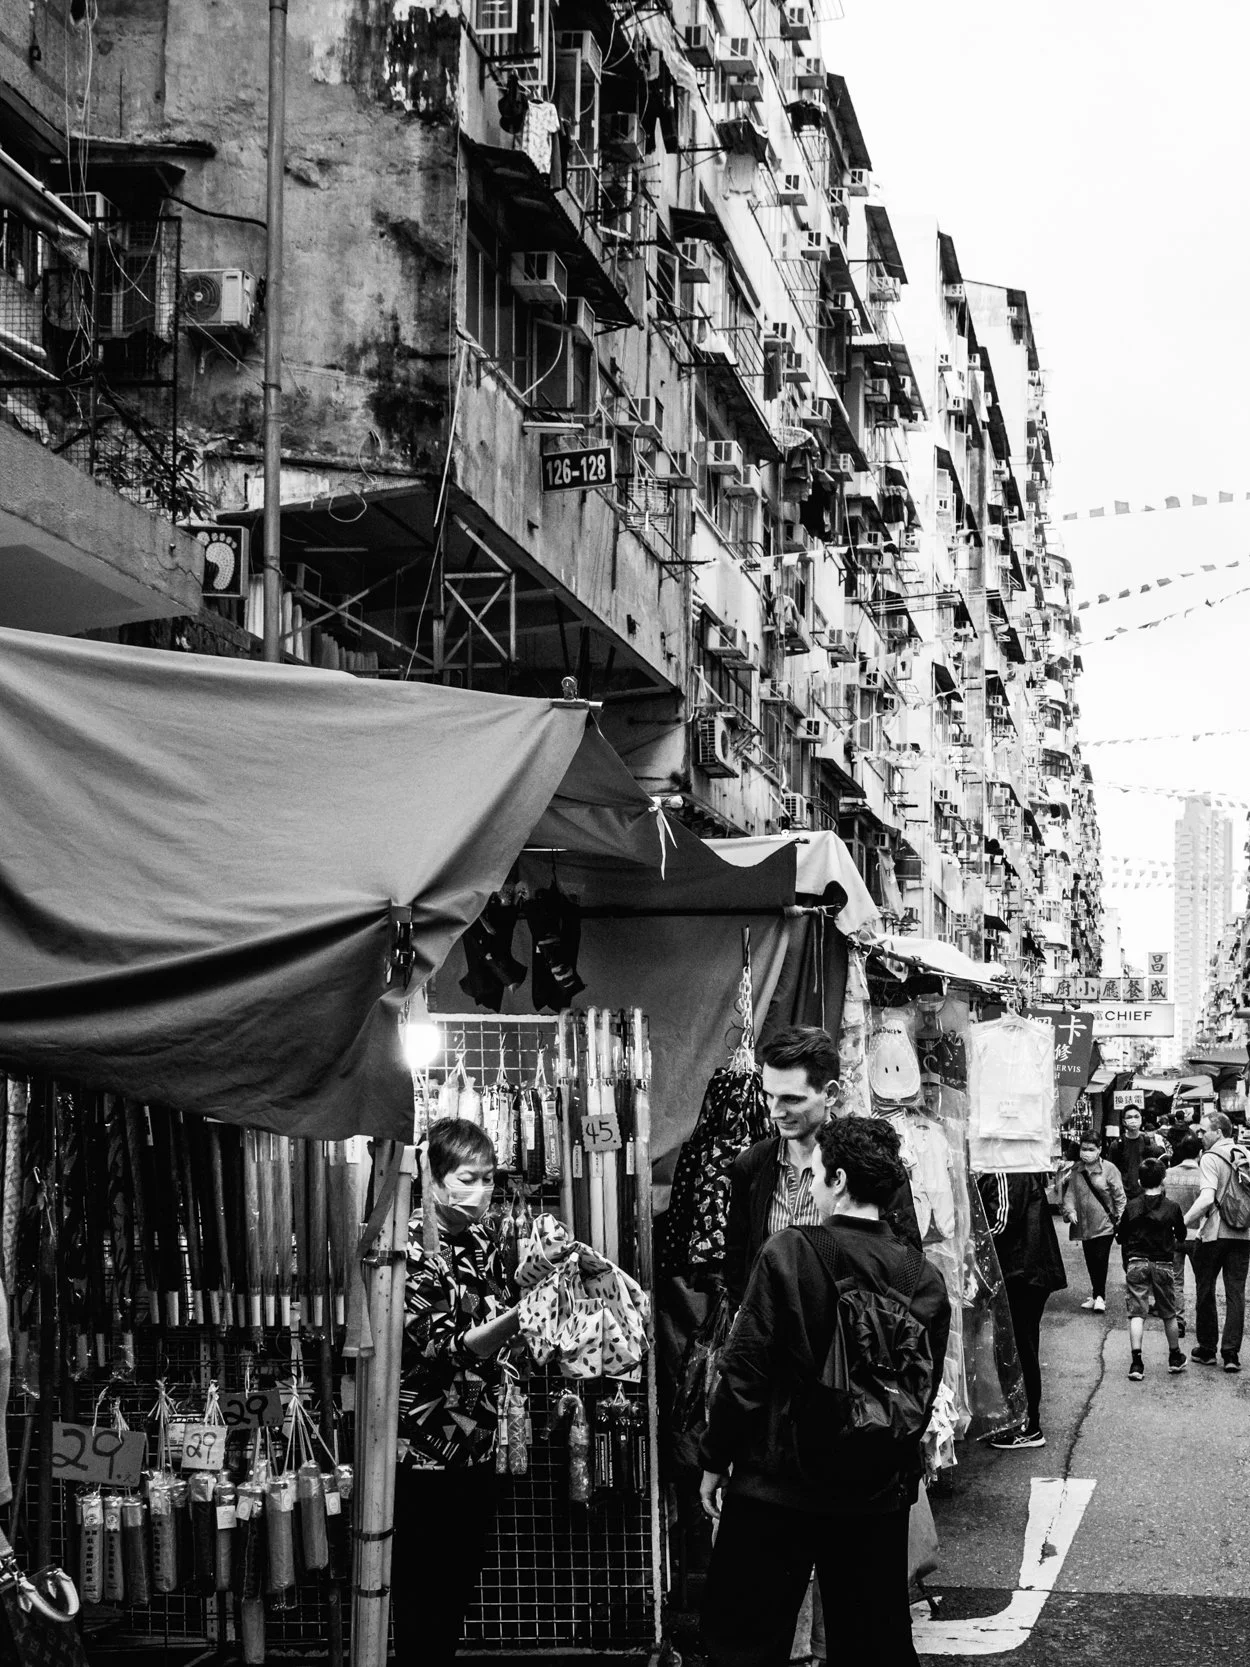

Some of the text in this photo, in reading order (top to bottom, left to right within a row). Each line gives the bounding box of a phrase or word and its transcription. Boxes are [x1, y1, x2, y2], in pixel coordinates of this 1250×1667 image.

[546, 454, 606, 485] 126-128
[1104, 1010, 1153, 1021] CHIEF
[1056, 1065, 1082, 1073] ERVIS
